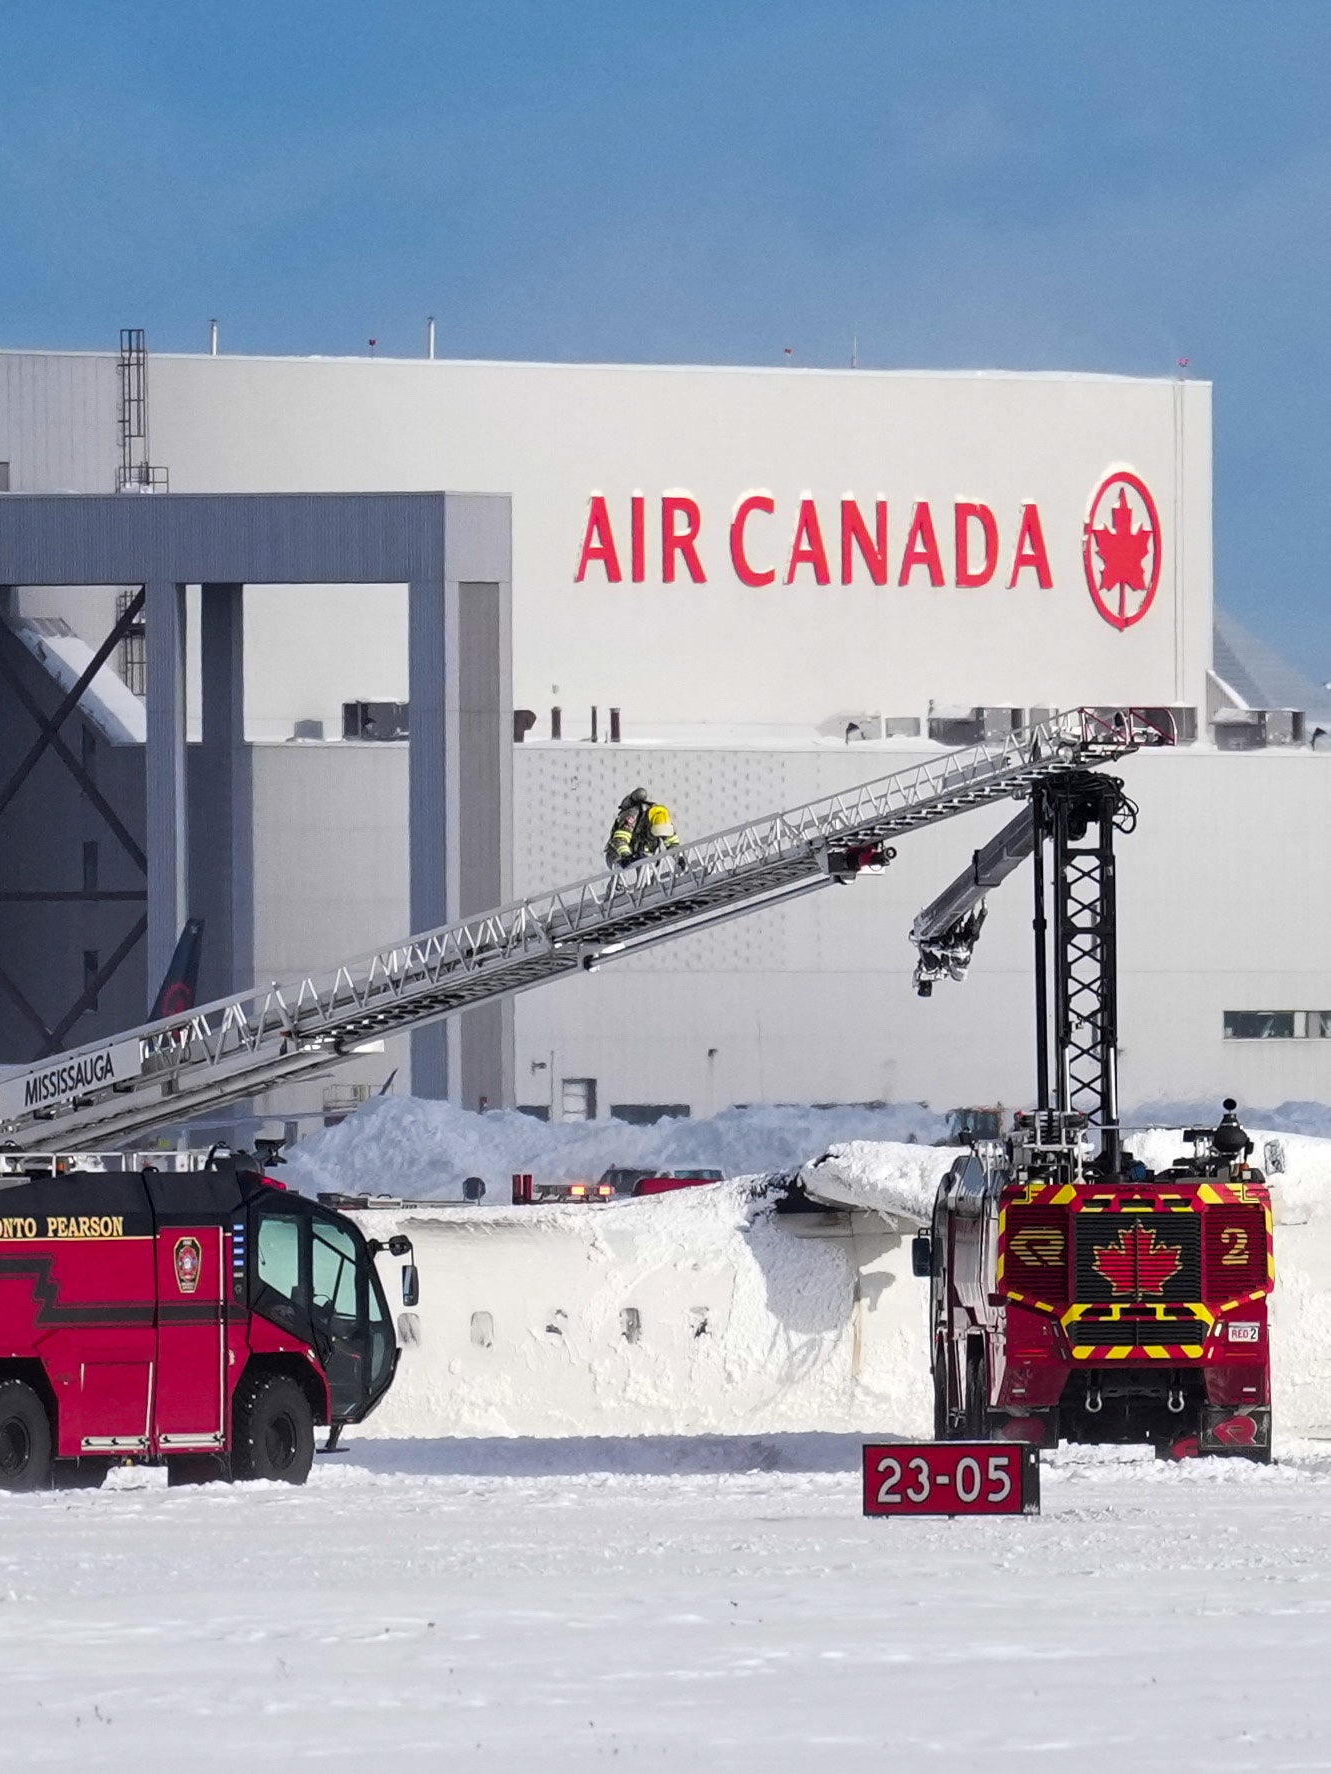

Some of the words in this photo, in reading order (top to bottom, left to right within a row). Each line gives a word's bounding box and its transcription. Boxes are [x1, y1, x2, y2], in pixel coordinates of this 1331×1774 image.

[574, 493, 708, 584] AIR
[729, 493, 1054, 589] CANADA
[24, 1051, 115, 1107] MISSISSAUGA
[47, 1216, 124, 1237] PEARSON
[1221, 1227, 1250, 1265] 2
[1231, 1328, 1249, 1339] RED
[1250, 1327, 1257, 1340] 2
[876, 1456, 1012, 1504] 23-05
